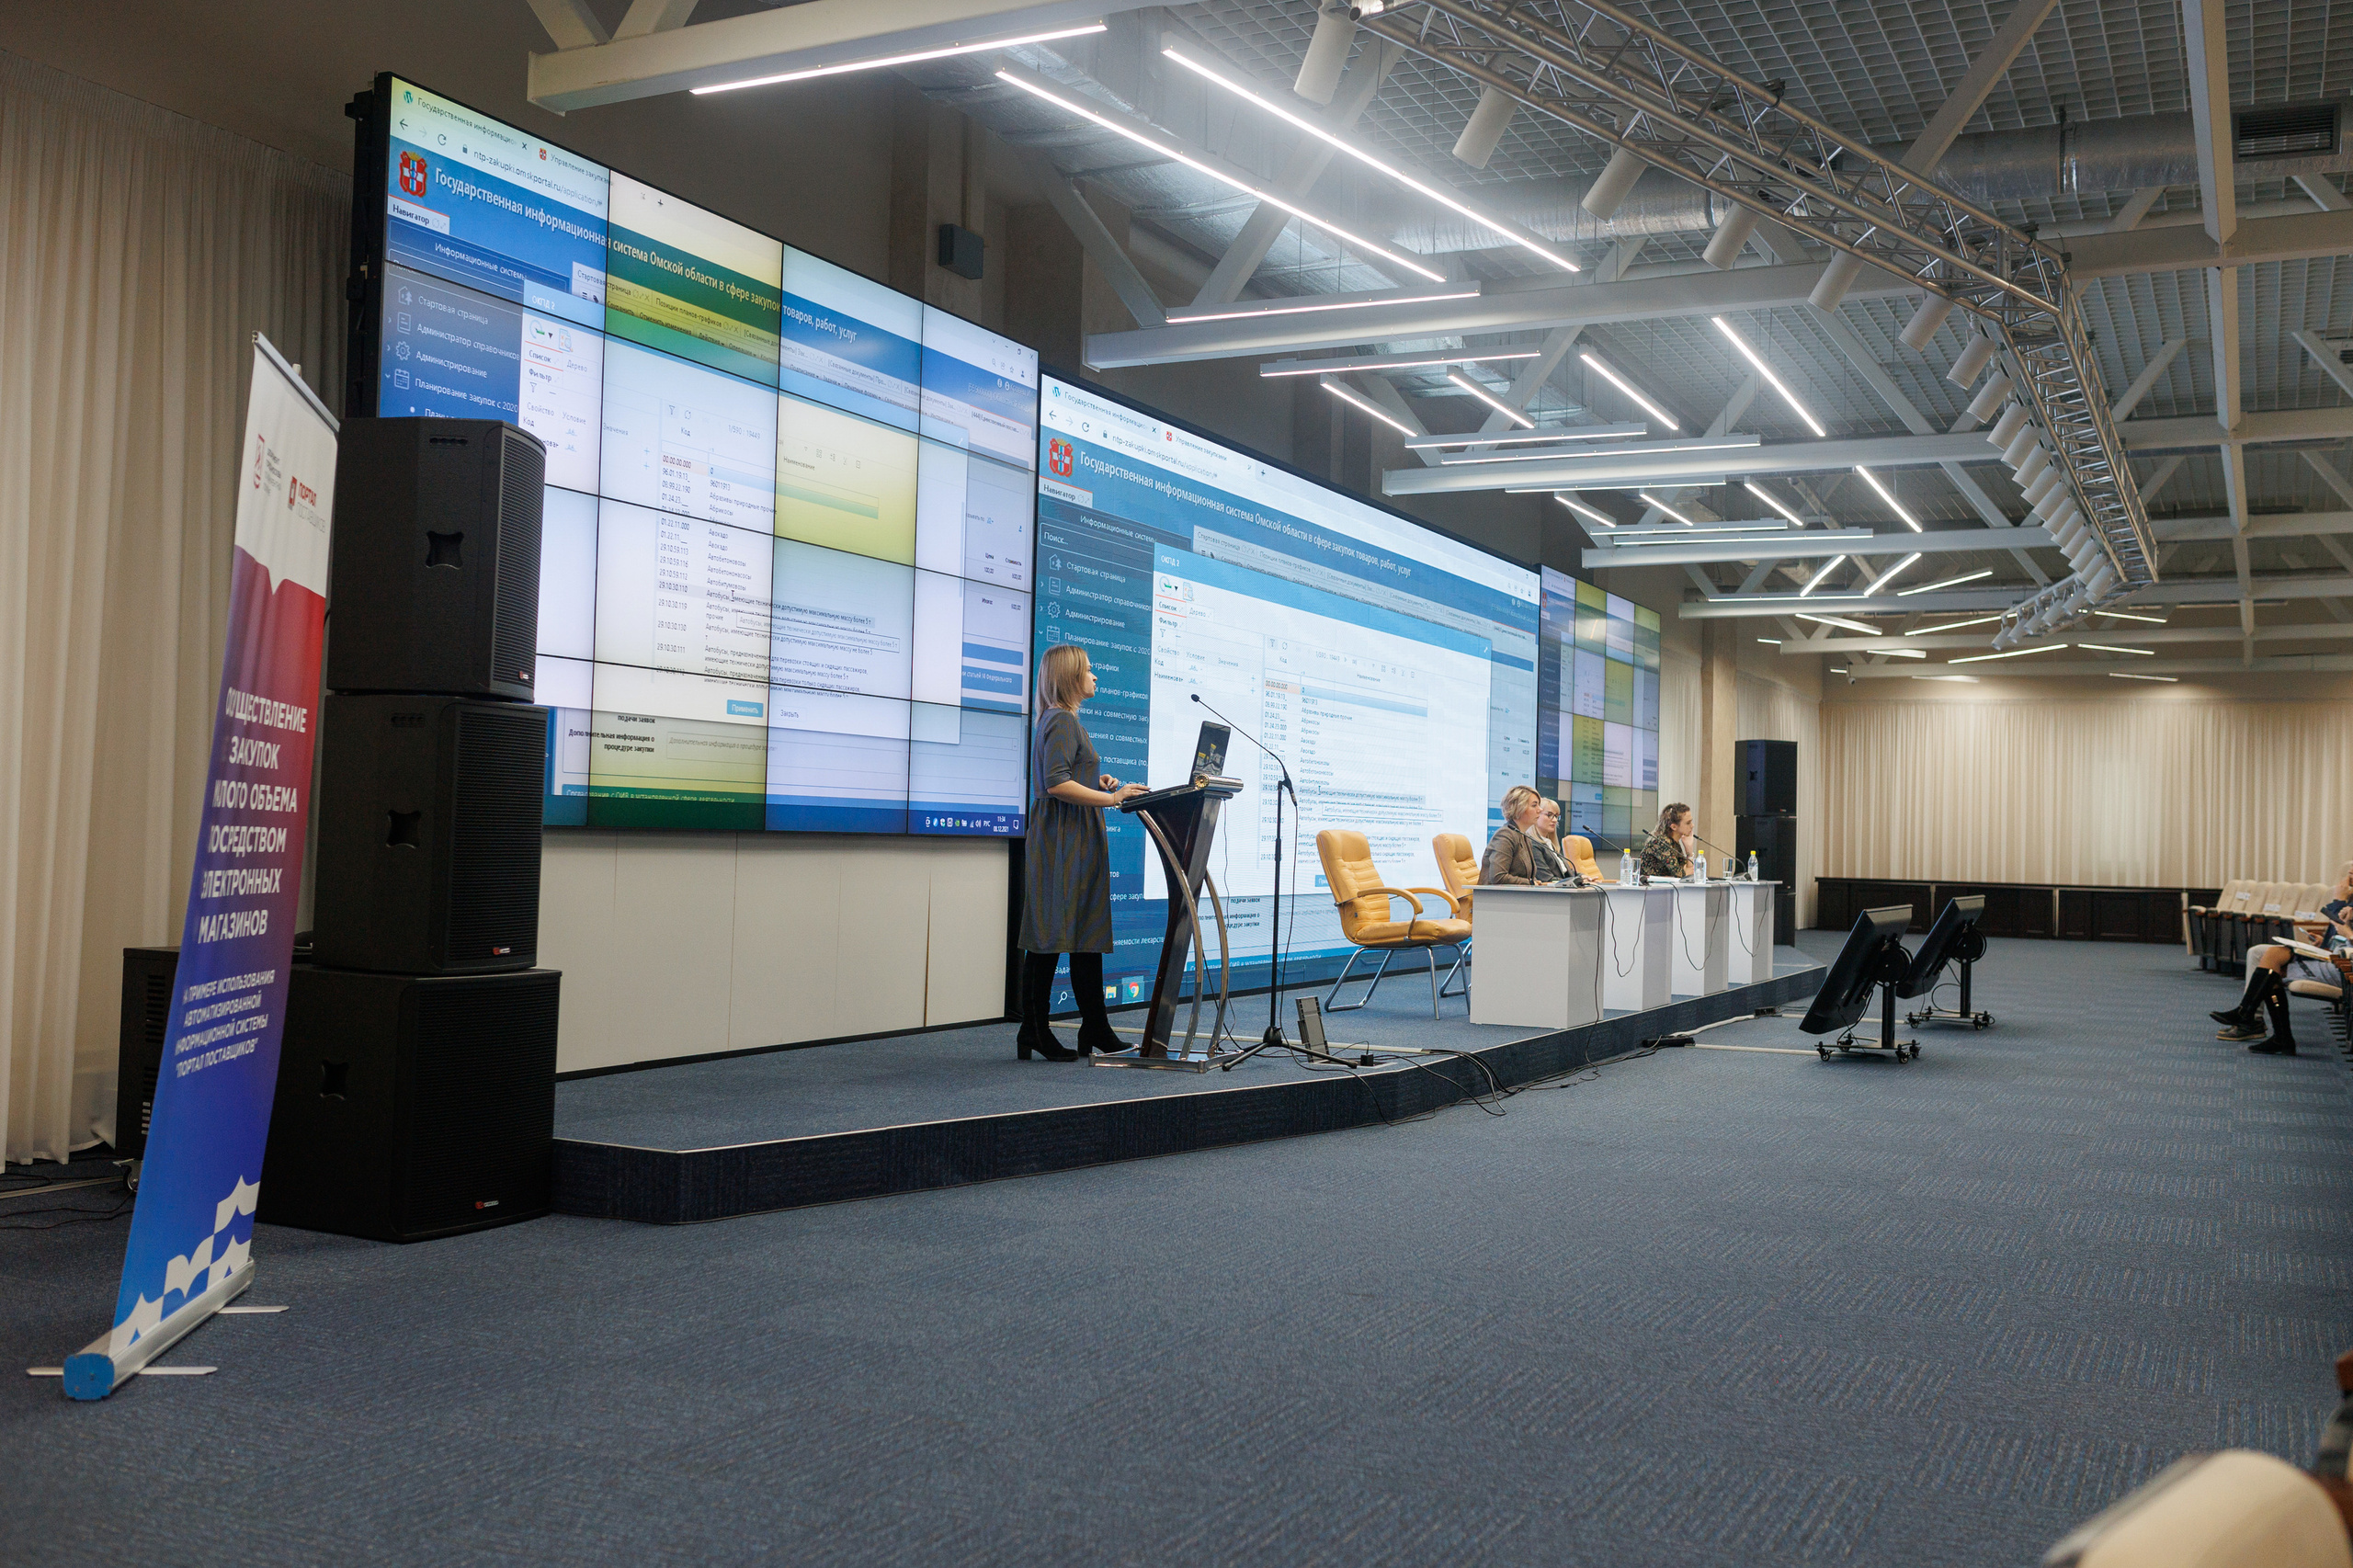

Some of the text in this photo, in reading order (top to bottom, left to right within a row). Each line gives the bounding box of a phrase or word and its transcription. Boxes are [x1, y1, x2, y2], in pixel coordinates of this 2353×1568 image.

[392, 204, 430, 225] Навигатор
[435, 167, 523, 215] Государственная
[525, 205, 612, 250] информационная
[613, 238, 648, 262] система
[650, 251, 684, 276] Омской
[686, 267, 718, 289] области
[726, 283, 749, 302] сфере
[751, 293, 780, 314] закупок
[783, 304, 813, 325] товаров,
[815, 318, 837, 335] работ,
[839, 325, 857, 343] услуг
[435, 242, 498, 272] Информационные
[418, 296, 488, 325] Стартовая страница
[532, 295, 550, 310] ОКПД
[417, 324, 471, 347] Администратор
[416, 350, 487, 379] Администрирование
[529, 350, 588, 373] Список Дерево
[529, 369, 552, 382] Фильтр
[415, 378, 467, 400] Планирование
[470, 393, 495, 408] закупок
[523, 416, 535, 427] Код
[528, 402, 554, 417] Свойство
[563, 411, 586, 426] Условие
[681, 426, 691, 437] Код
[1043, 483, 1076, 501] Навигатор
[1080, 450, 1154, 489] Государственная
[1155, 479, 1224, 513] информационная
[1225, 503, 1254, 523] система
[1256, 513, 1281, 532] Омской
[1283, 525, 1308, 540] области
[1313, 535, 1332, 551] сфере
[1332, 543, 1355, 560] закупок
[1356, 550, 1380, 567] товаров,
[1381, 558, 1397, 573] работ,
[1397, 564, 1412, 579] услуг
[709, 528, 728, 540] Авокадо
[1080, 516, 1133, 538] Информационные
[708, 540, 728, 551] Авокадо
[1161, 555, 1176, 566] ОКПД
[1066, 562, 1126, 584] Стартовая страница
[1066, 585, 1112, 604] Администратор
[1159, 601, 1176, 612] Список
[1065, 608, 1125, 629] Администрирование
[1064, 632, 1109, 649] Планирование
[1111, 641, 1131, 653] закупок
[780, 710, 799, 718] Закрыть
[1104, 710, 1137, 722] совместную
[1115, 734, 1147, 744] совместных
[229, 735, 280, 769] ЗАКУПОК
[1104, 756, 1137, 767] поставщика
[250, 784, 298, 812] ОБЪЕМА
[1110, 892, 1127, 902] сфере
[198, 910, 268, 943] МАГАЗИНОВ
[217, 970, 275, 994] ИСПОЛЬЗОВАНИЯ
[184, 990, 262, 1028] АВТОМАТИЗИРОВАННОЙ
[235, 1014, 268, 1035] СИСТЕМЫ
